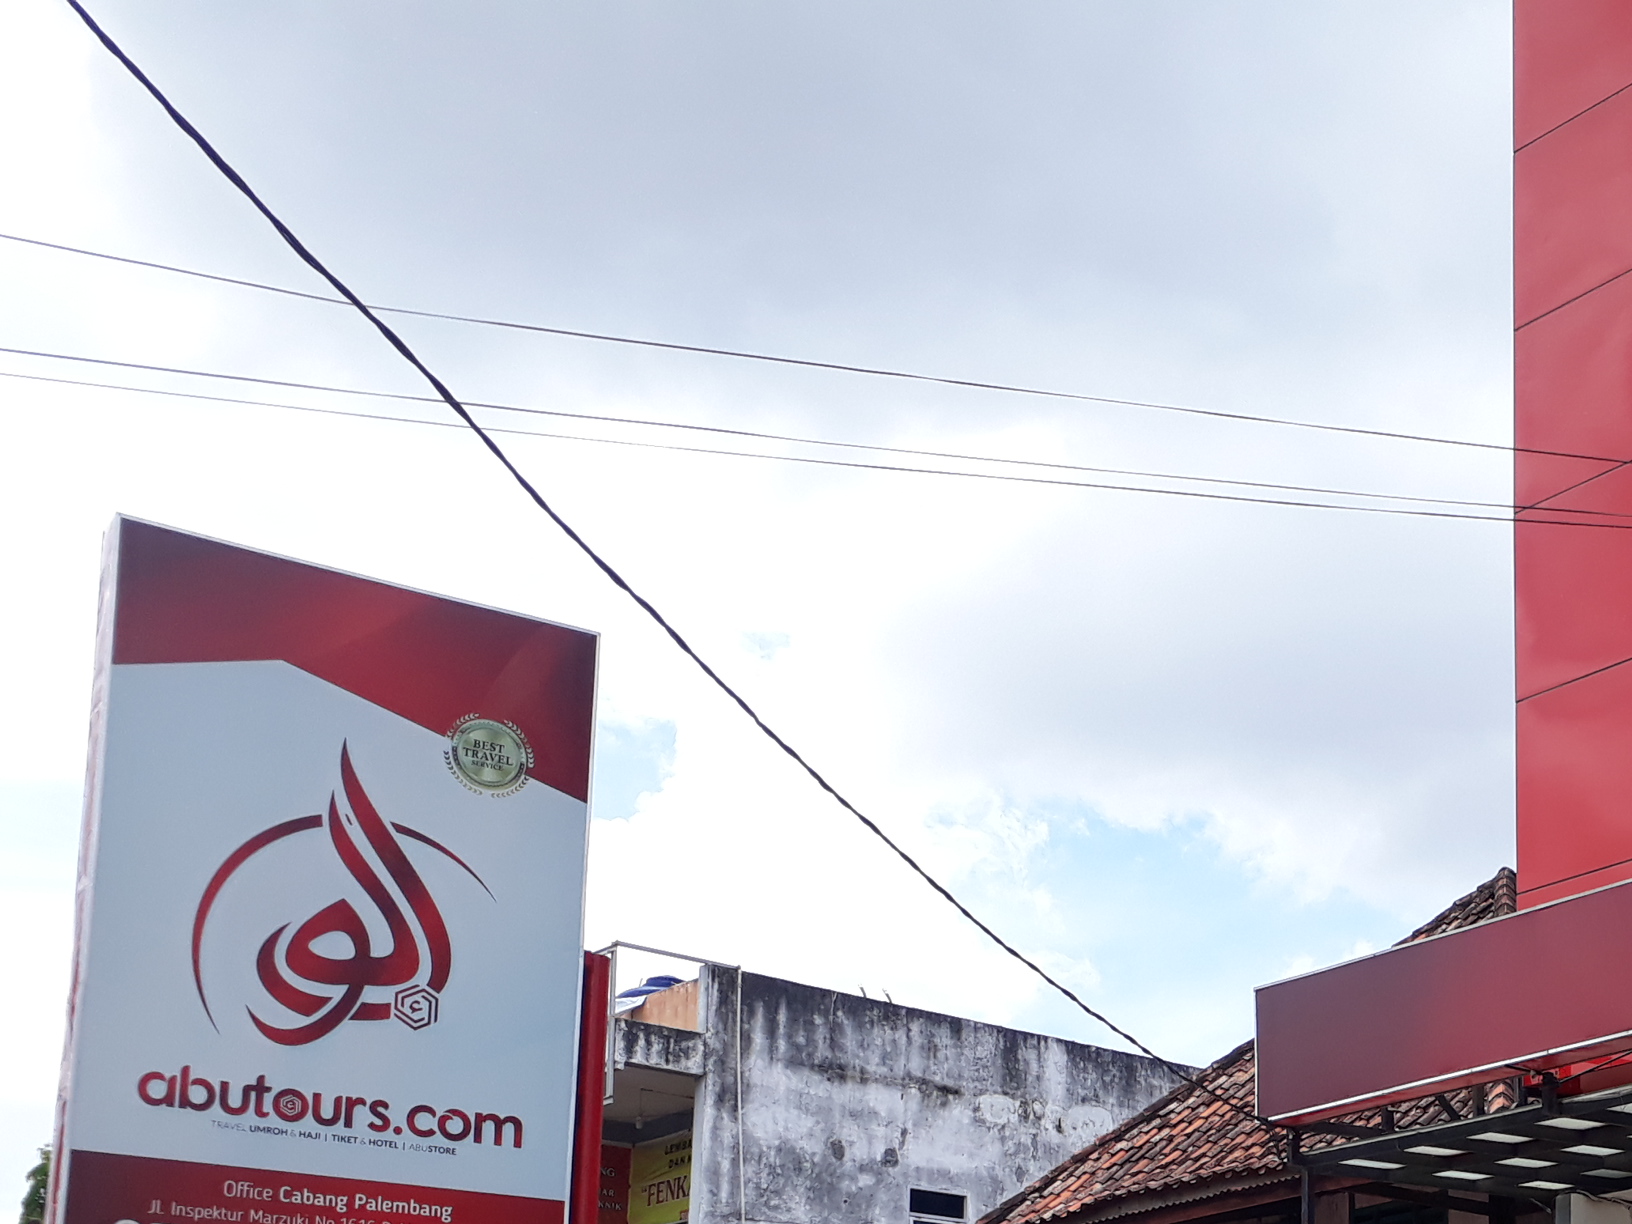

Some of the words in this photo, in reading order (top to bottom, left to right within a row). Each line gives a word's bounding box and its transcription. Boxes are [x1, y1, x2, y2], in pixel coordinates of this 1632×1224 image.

[462, 746, 514, 767] TRAVEL
[473, 739, 506, 754] BEST
[470, 759, 504, 772] SERVICE
[138, 1065, 523, 1149] abutours.com
[249, 1125, 288, 1137] UMROH
[299, 1130, 321, 1141] HAJI
[332, 1134, 358, 1145] TIKET
[369, 1138, 399, 1150] HOTEL
[409, 1142, 457, 1156] ABUSTORE
[171, 1201, 245, 1222] Inspektur
[223, 1180, 273, 1201] Office
[279, 1186, 348, 1213] Cabang
[354, 1193, 453, 1223] Palembang
